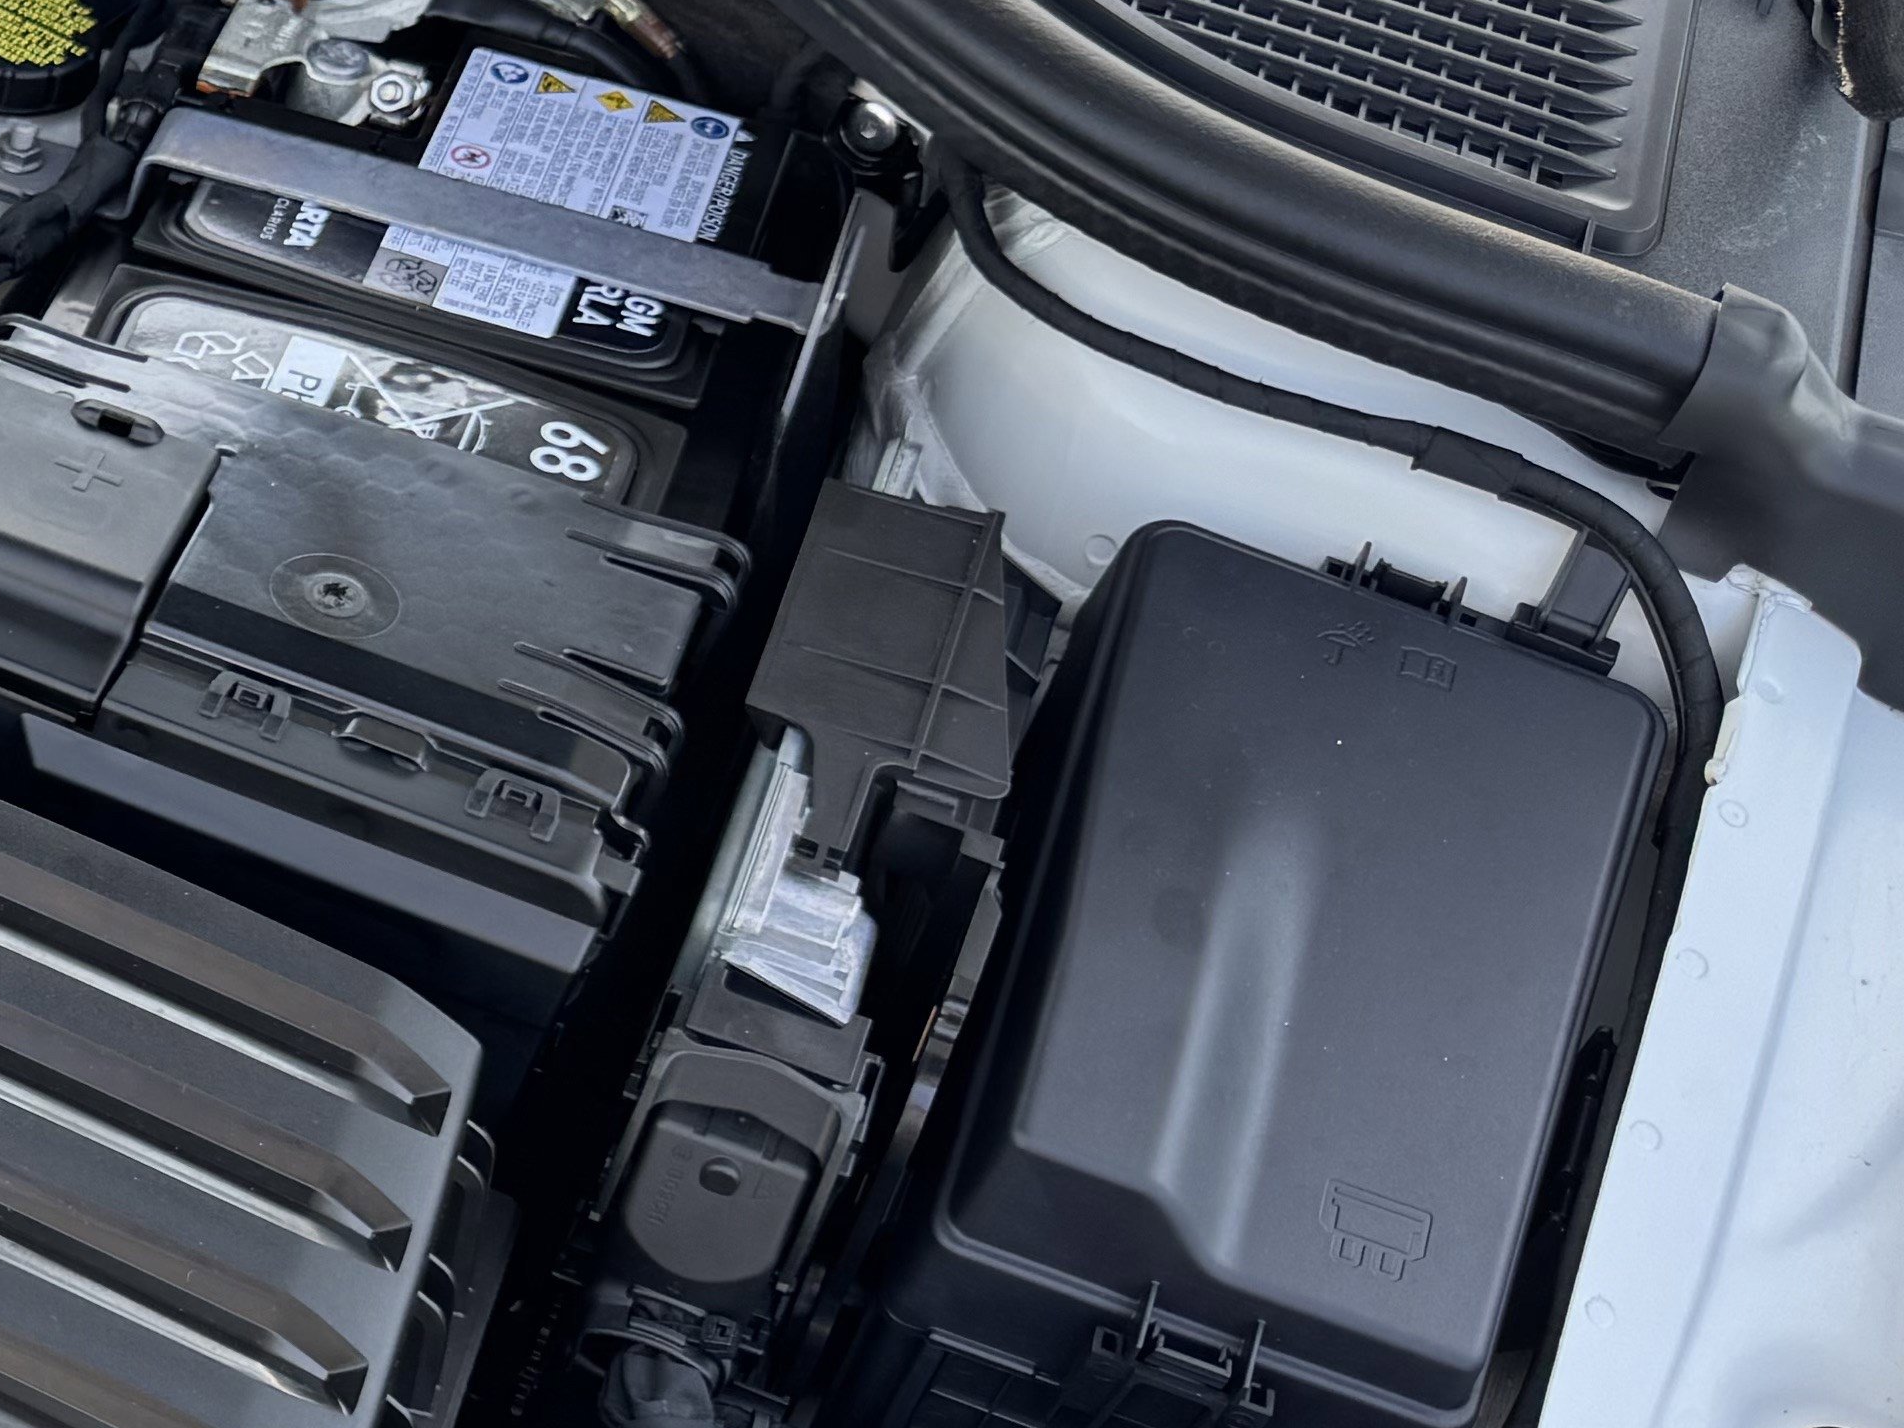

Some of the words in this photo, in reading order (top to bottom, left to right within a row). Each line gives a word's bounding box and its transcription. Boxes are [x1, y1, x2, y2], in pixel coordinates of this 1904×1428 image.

[258, 198, 289, 240] CLARIOS
[615, 296, 665, 337] GM
[527, 420, 610, 483] 68
